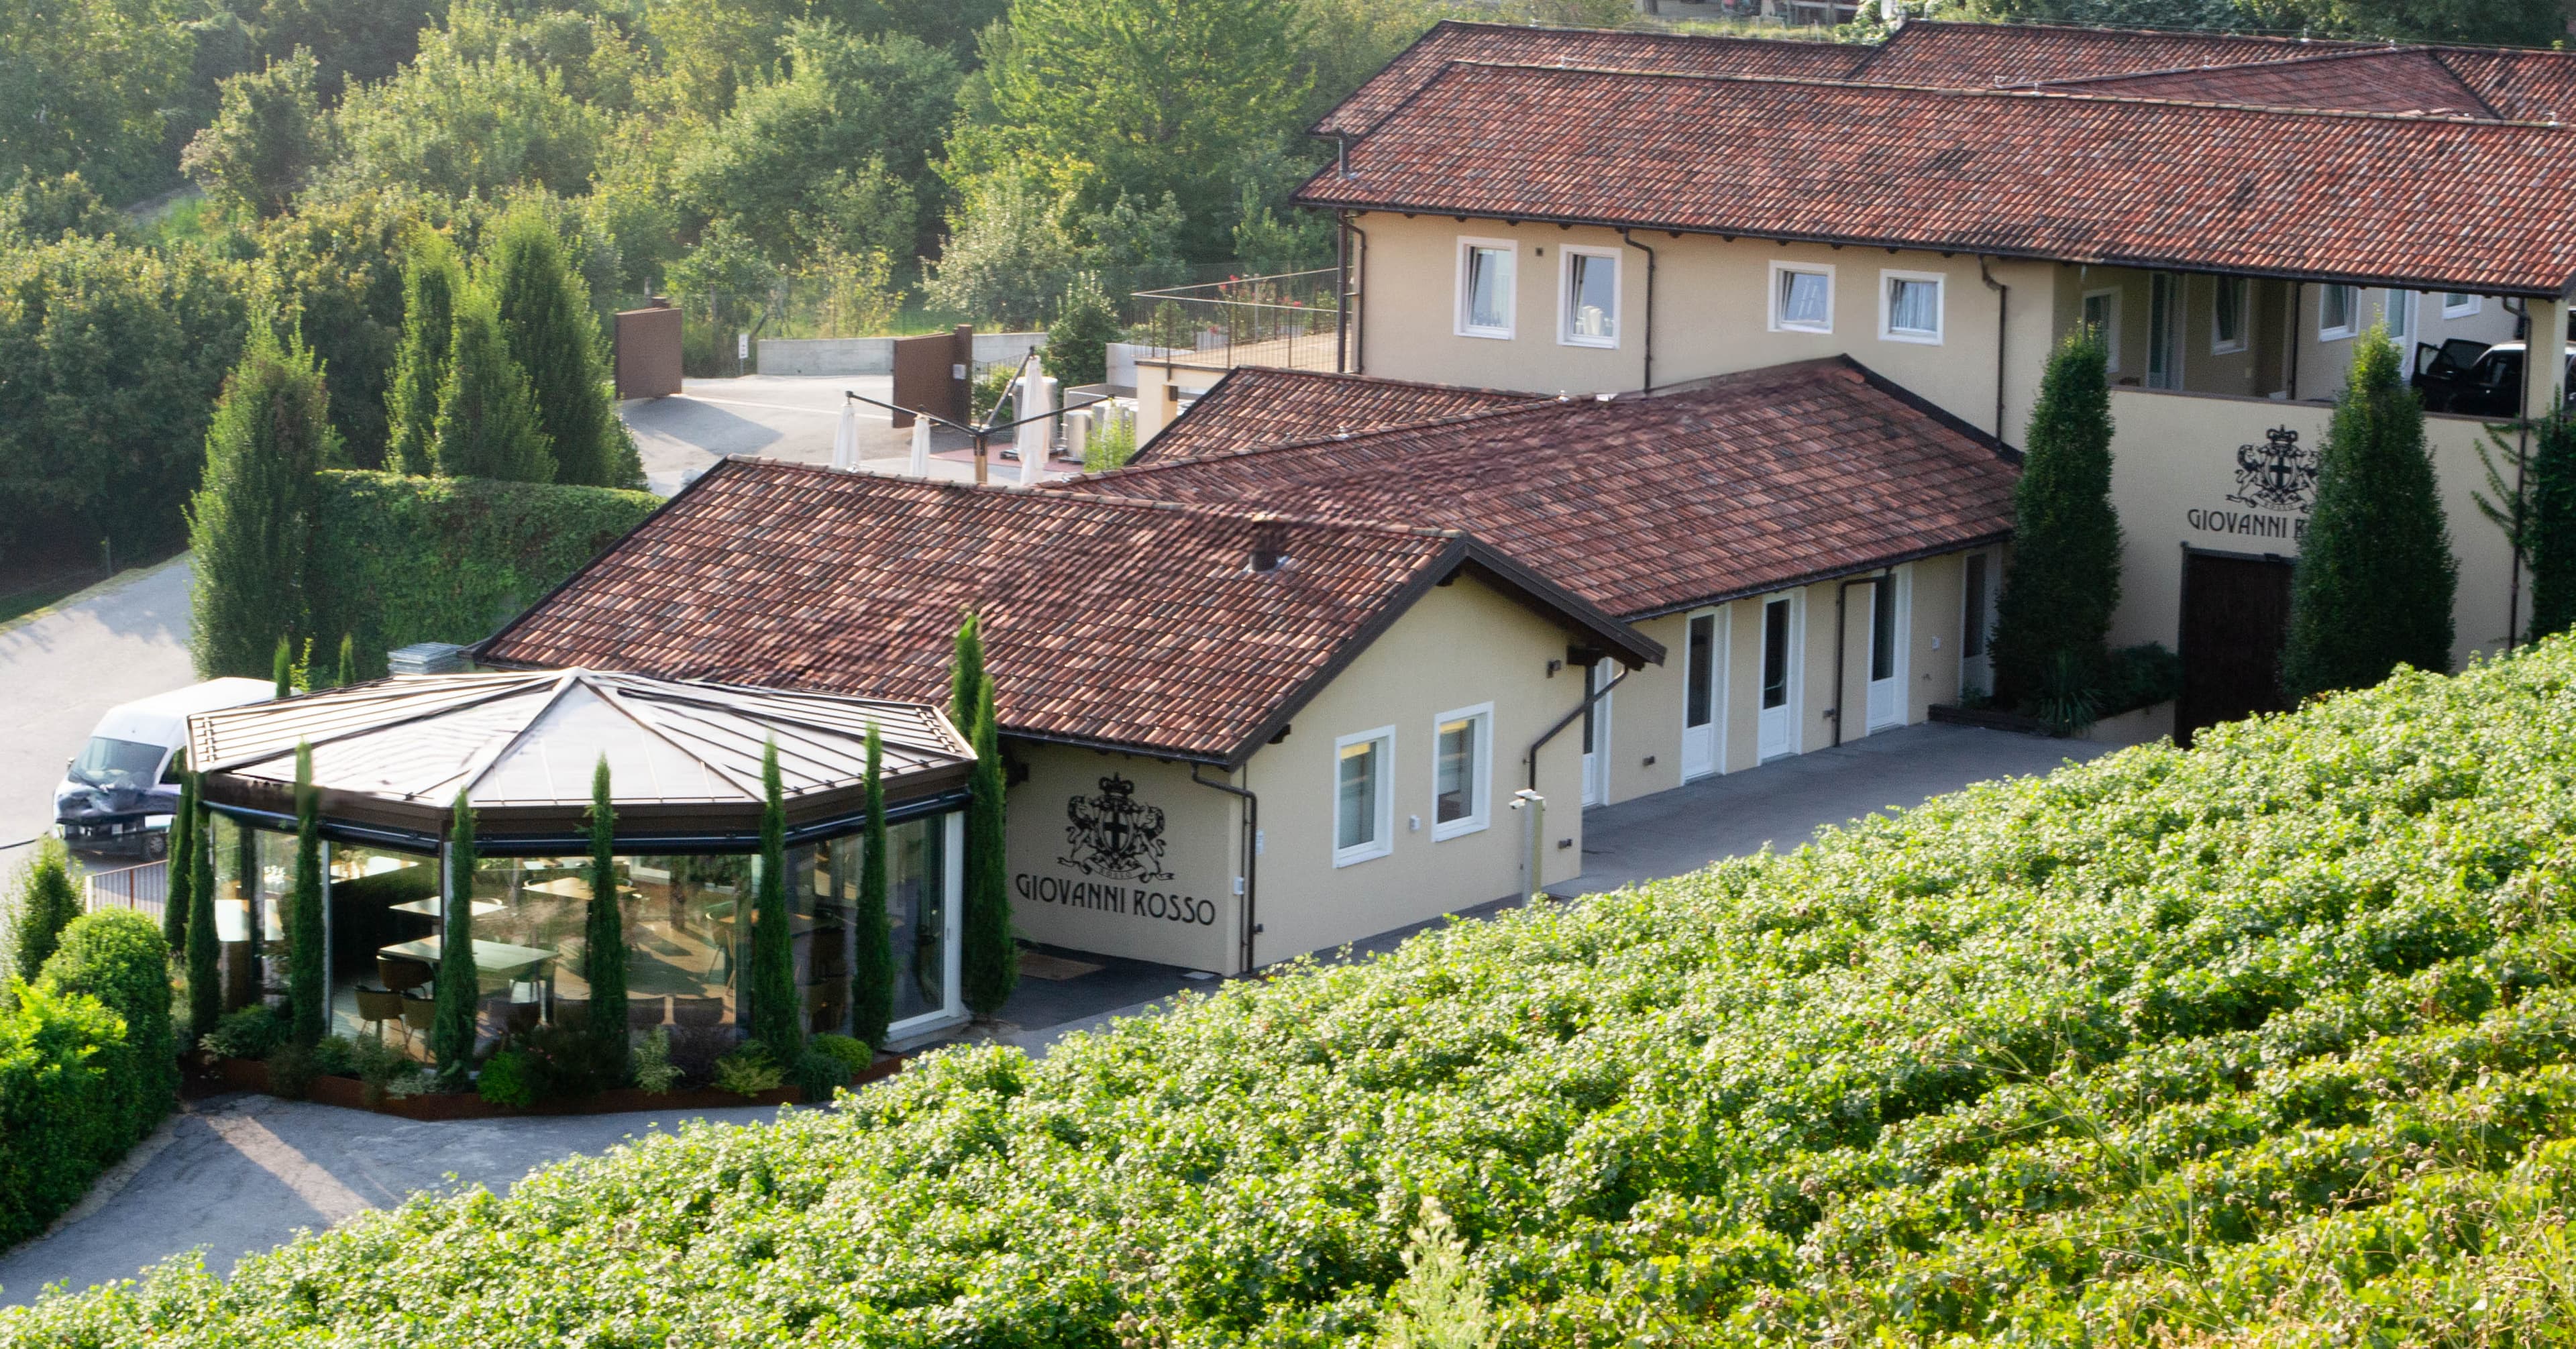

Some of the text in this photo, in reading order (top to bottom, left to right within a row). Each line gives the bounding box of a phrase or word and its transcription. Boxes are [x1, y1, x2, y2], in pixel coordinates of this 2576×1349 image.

[2188, 508, 2288, 539] GIOVANNI
[1015, 873, 1216, 926] GIOVANNI ROSSO
